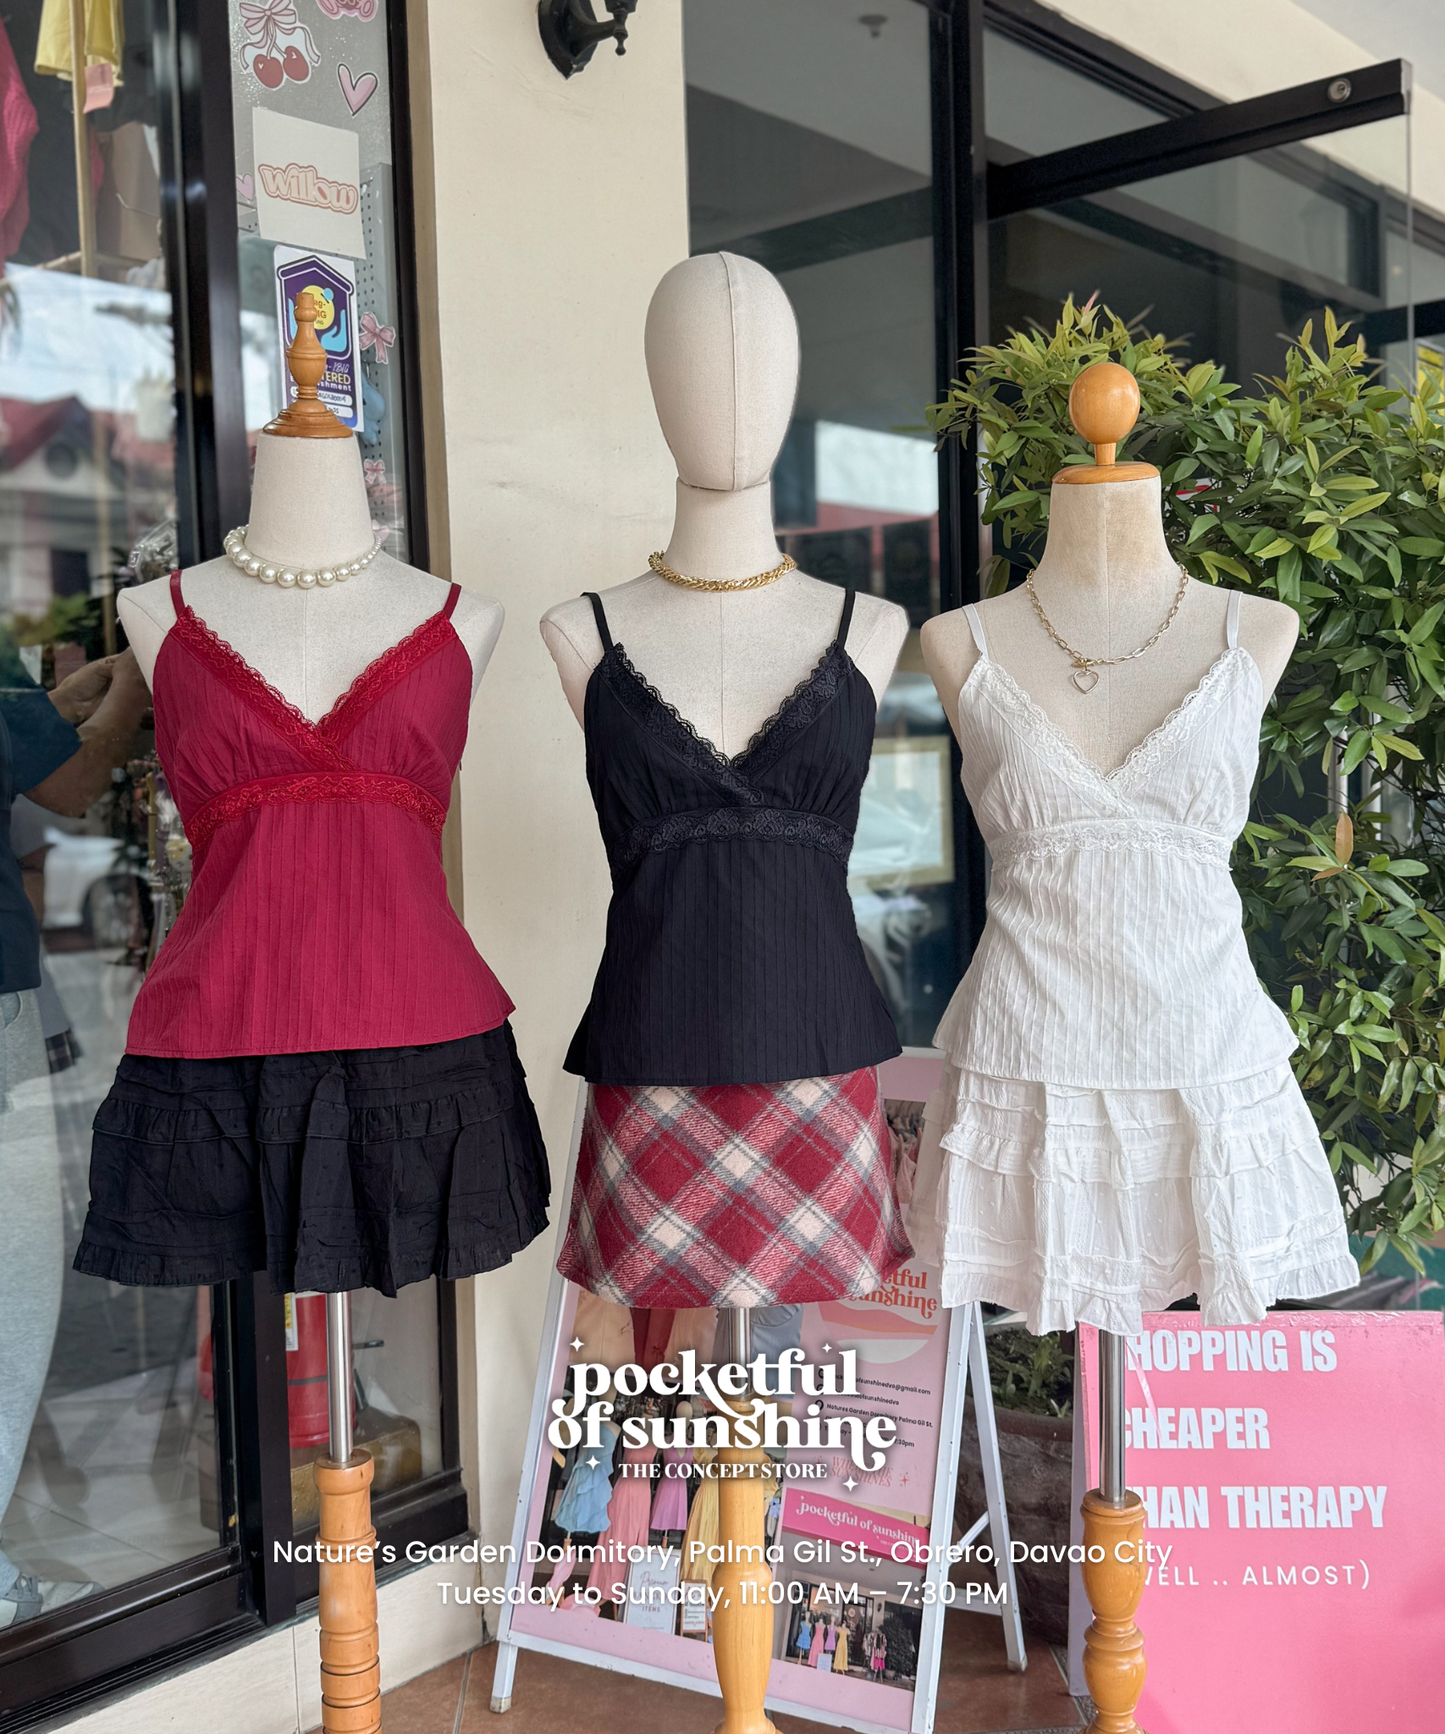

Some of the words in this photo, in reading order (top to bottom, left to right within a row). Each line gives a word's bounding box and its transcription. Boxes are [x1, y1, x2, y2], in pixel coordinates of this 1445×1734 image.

[1125, 1329, 1288, 1372] HOPPING
[1301, 1330, 1338, 1372] IS
[1125, 1486, 1210, 1529] HAN
[1221, 1485, 1388, 1529] THERAPY
[1241, 1560, 1371, 1590] ALMOST)
